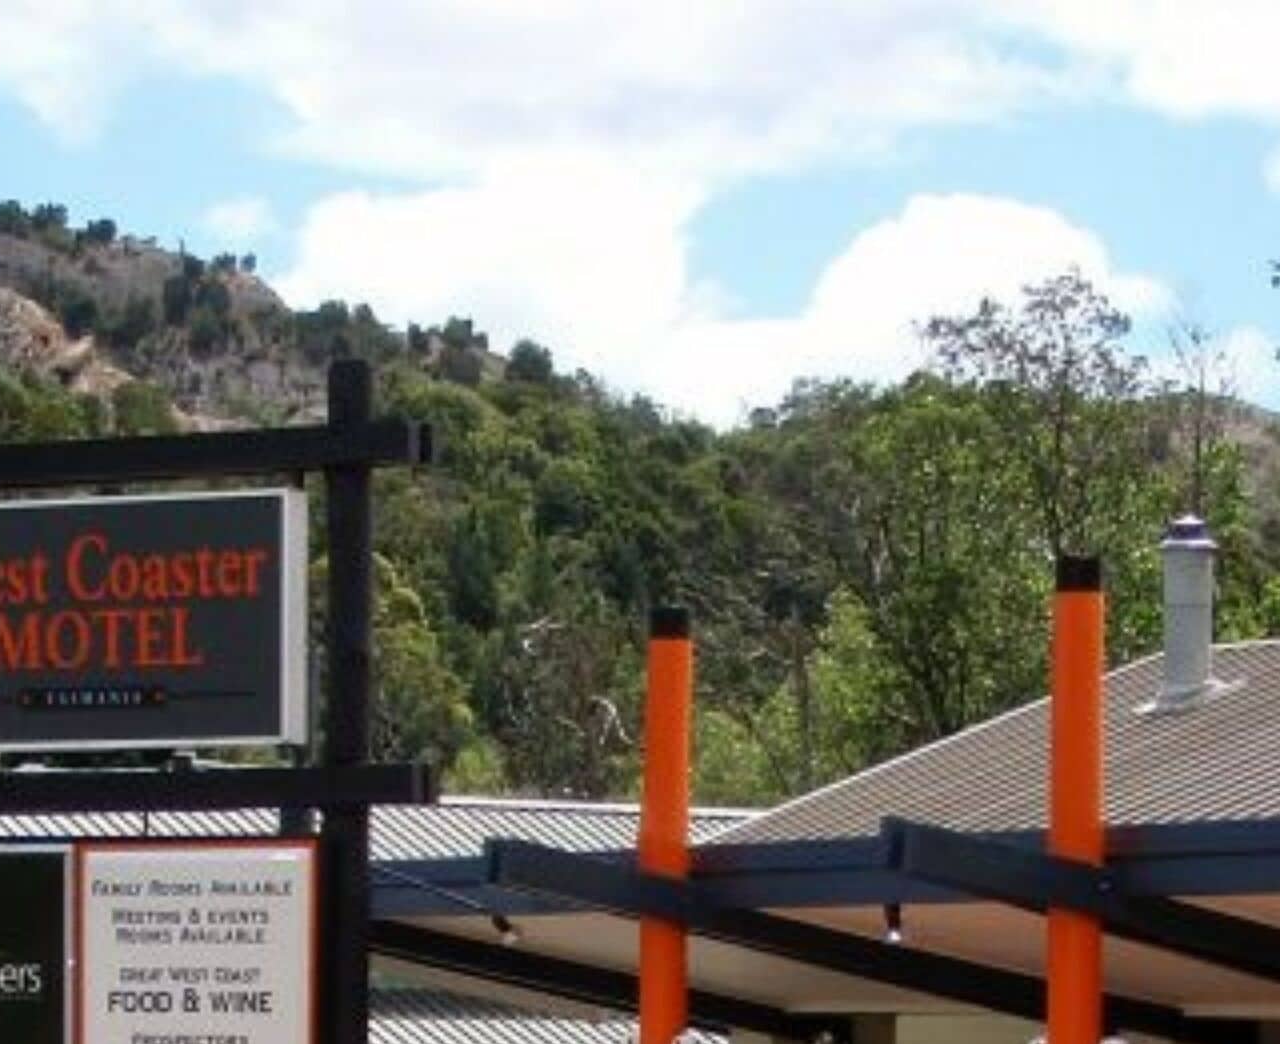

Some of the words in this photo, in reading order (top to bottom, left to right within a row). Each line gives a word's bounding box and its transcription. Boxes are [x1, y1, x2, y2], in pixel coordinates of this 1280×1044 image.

[64, 534, 267, 601] Coaster
[208, 911, 269, 924] EVENTS
[107, 991, 173, 1013] FOOD
[183, 988, 201, 1013] &
[209, 991, 273, 1013] WINE
